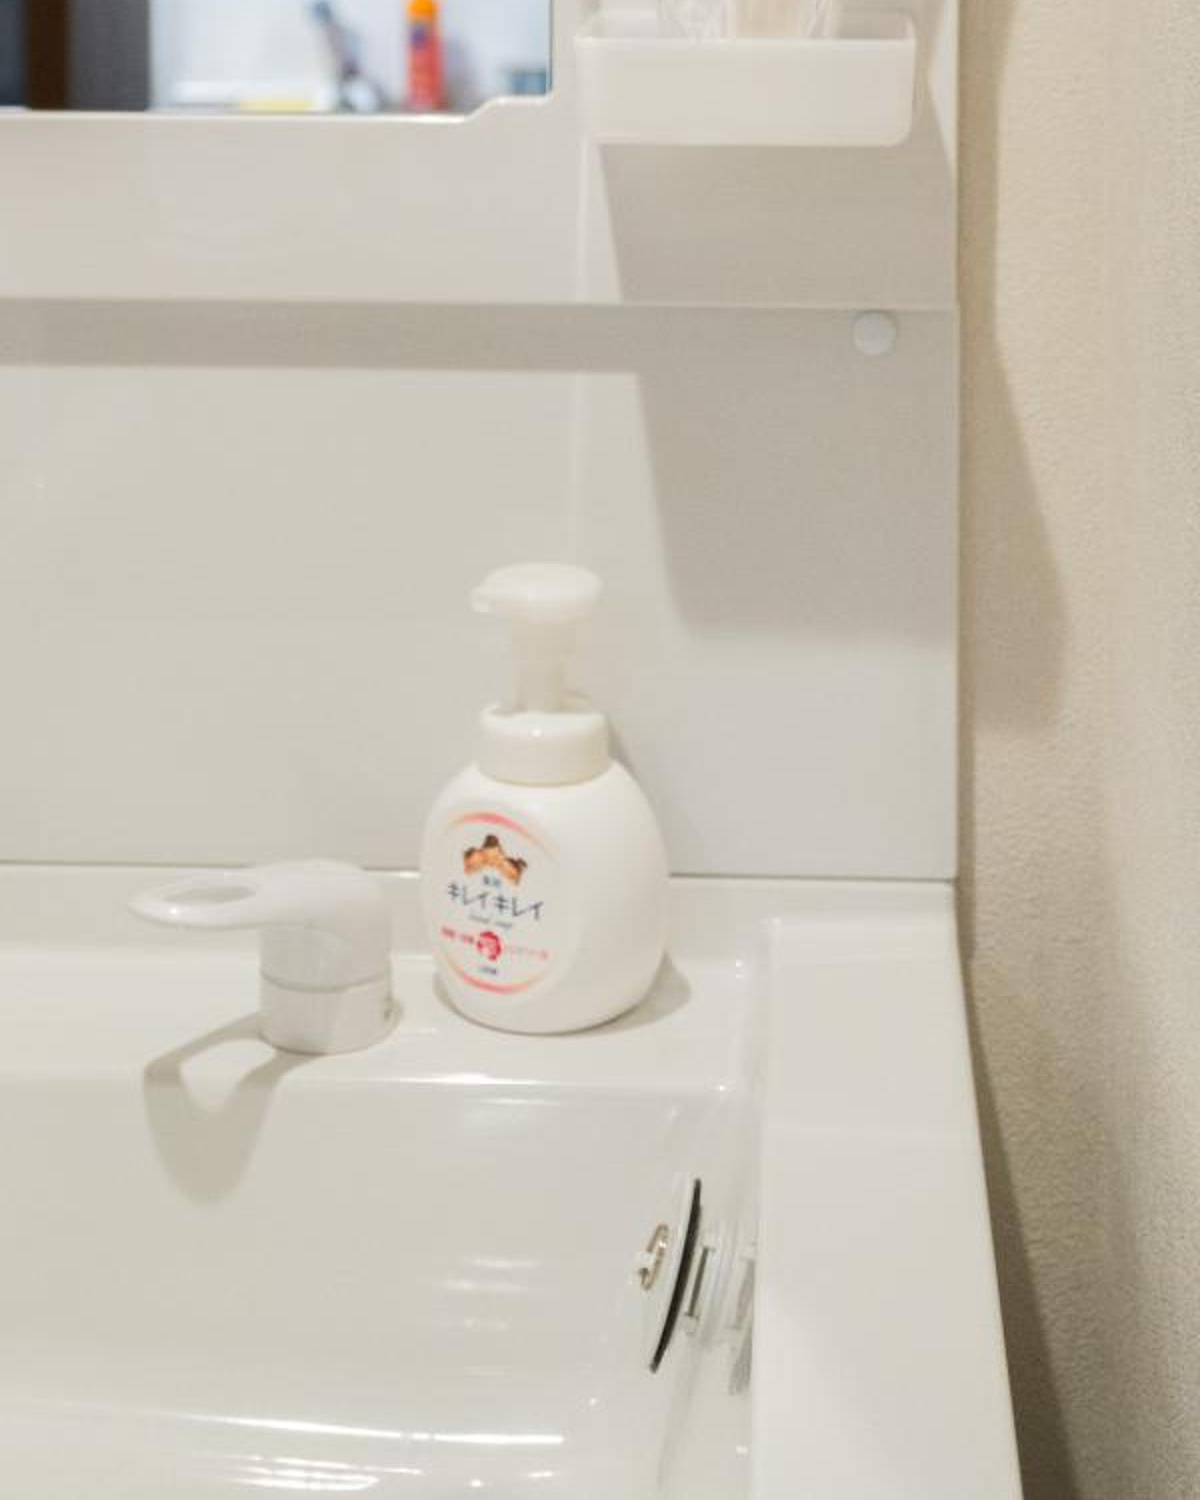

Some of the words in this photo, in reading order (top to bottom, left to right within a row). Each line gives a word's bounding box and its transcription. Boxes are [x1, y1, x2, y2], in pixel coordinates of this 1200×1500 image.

[447, 883, 544, 920] キレイキレイ
